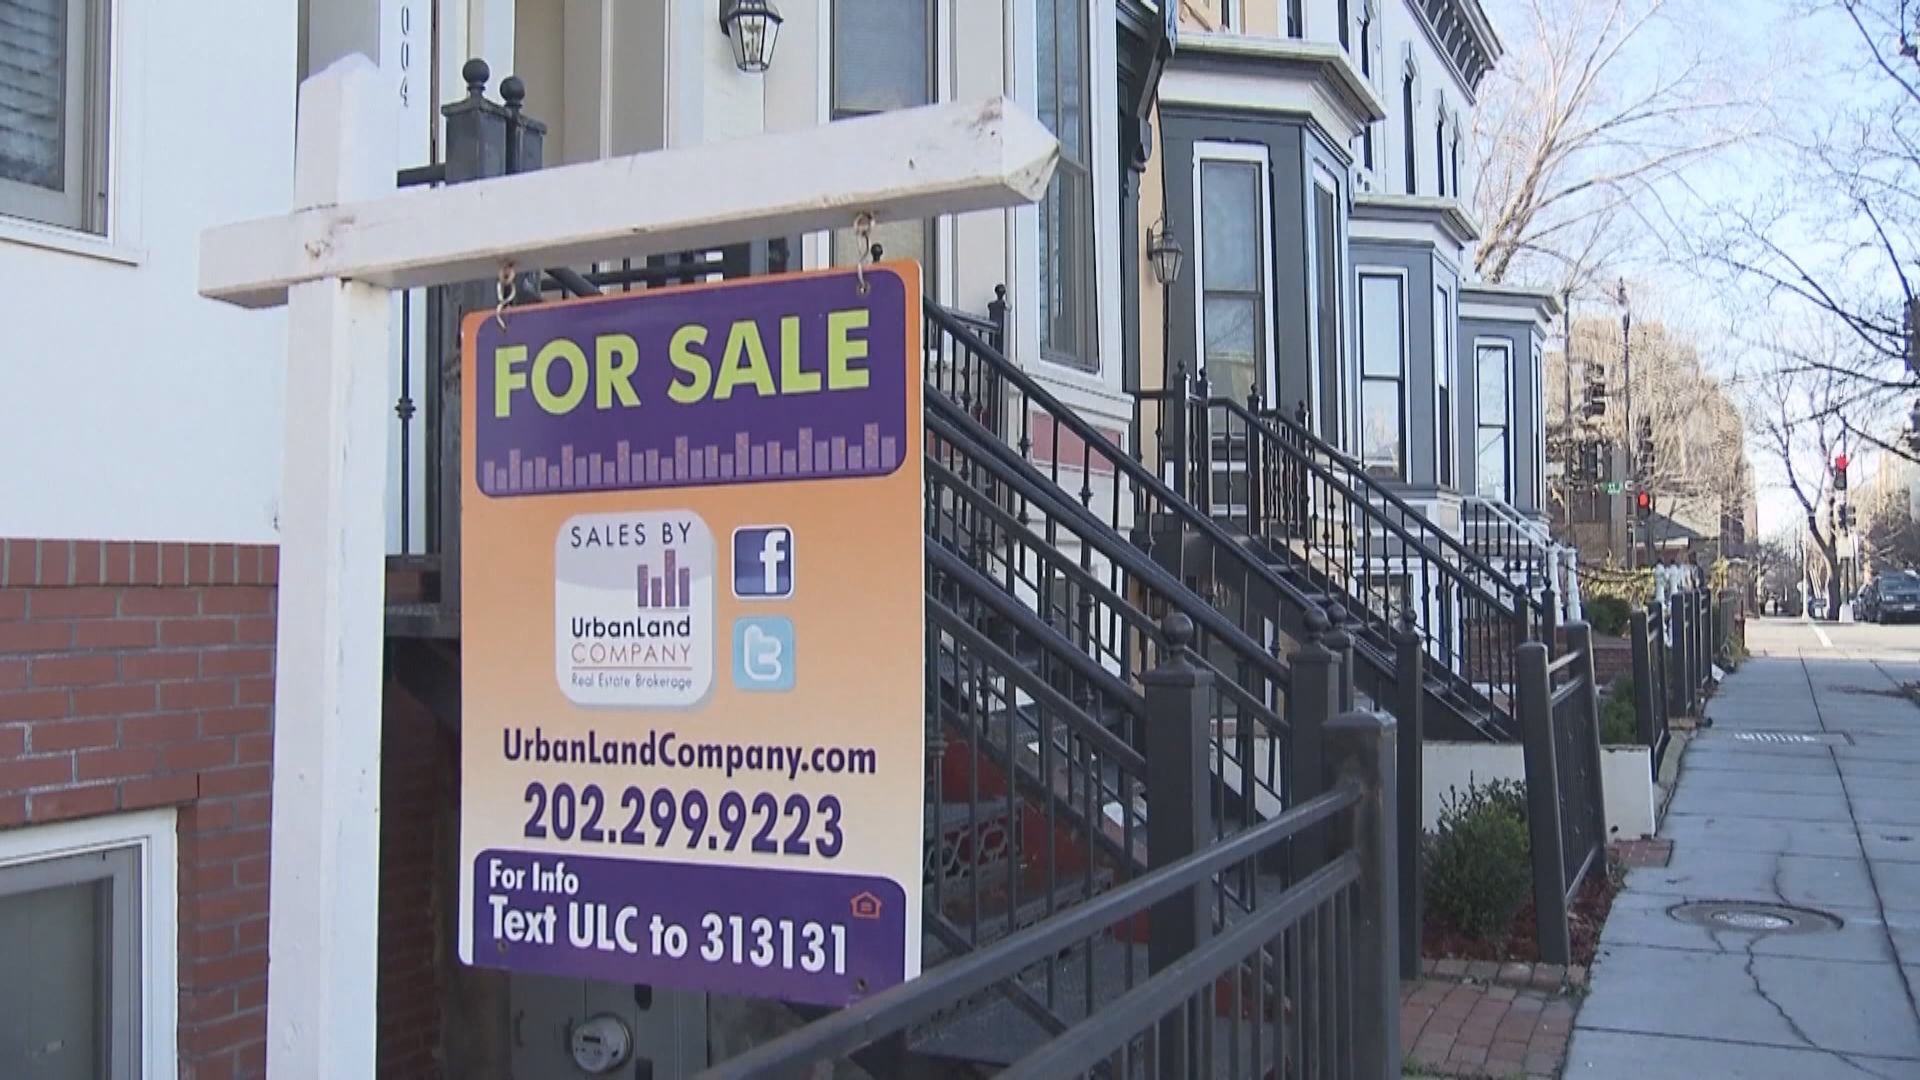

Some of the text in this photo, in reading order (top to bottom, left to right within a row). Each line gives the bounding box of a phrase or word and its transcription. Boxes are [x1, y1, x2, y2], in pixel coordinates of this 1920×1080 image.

[494, 309, 870, 418] FOR SALE
[571, 521, 692, 547] SALES BY
[572, 616, 690, 638] UrbanLand
[571, 642, 691, 664] COMPANY
[572, 672, 692, 690] Real Estate Brokerage
[503, 728, 876, 779] UrbanLandCompany.com
[524, 782, 843, 858] 202.299.9223
[489, 859, 579, 894] For Info
[488, 896, 846, 975] Text ULC to 313131
